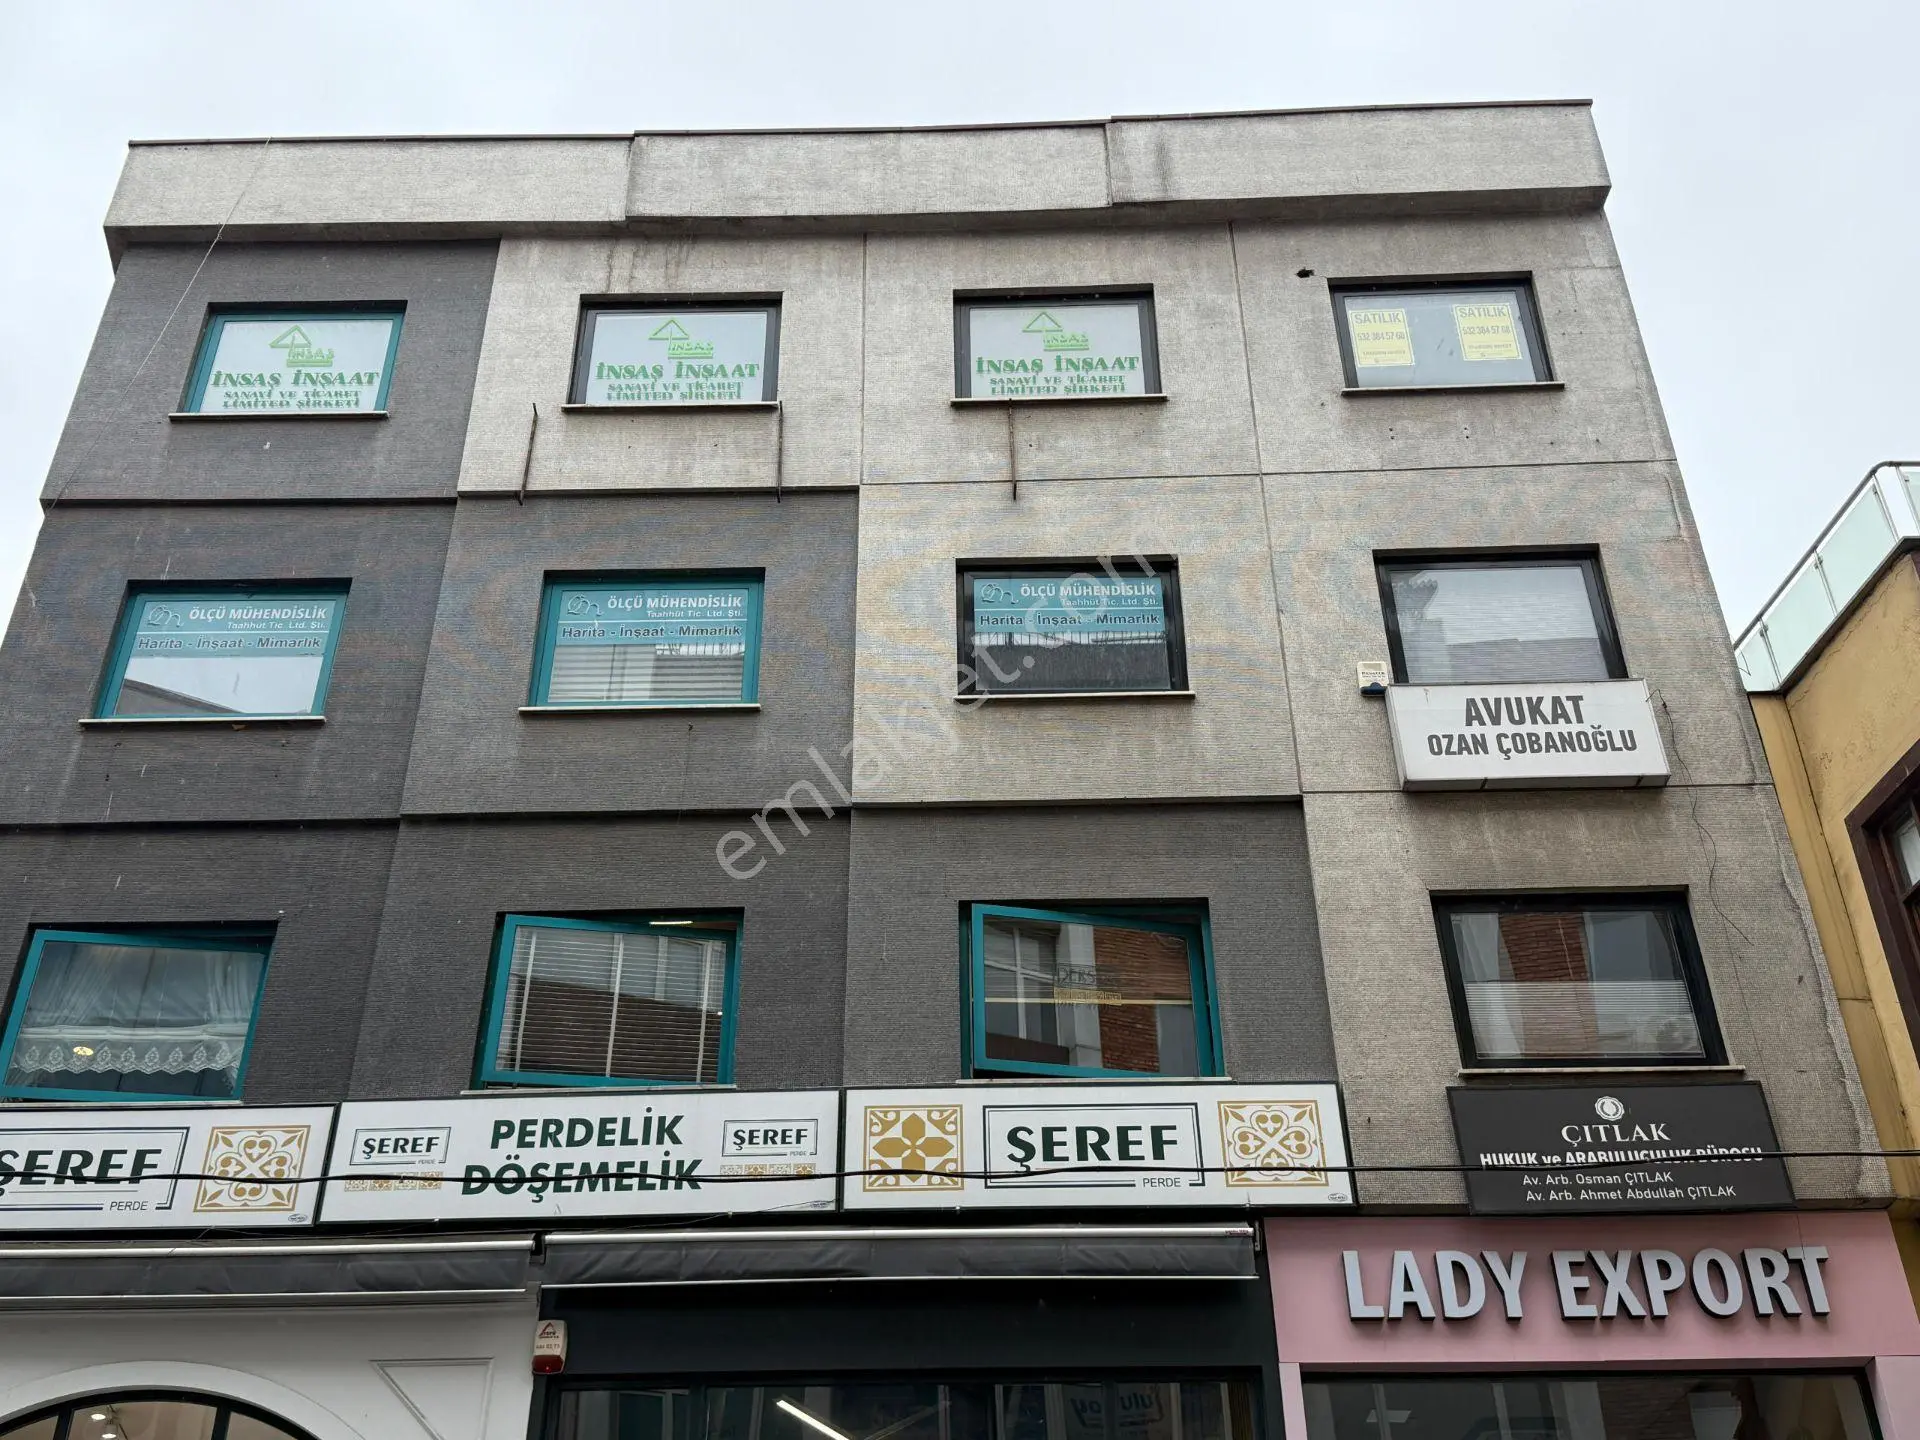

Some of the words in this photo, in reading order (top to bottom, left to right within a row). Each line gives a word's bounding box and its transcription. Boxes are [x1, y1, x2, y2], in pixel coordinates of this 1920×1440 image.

[1354, 312, 1402, 324] SATILIK
[1459, 306, 1507, 318] SATILIK
[673, 361, 759, 381] İNŞAAT
[1053, 354, 1139, 374] İNŞAAT
[291, 369, 379, 389] İNŞAAT
[607, 381, 655, 392] SANAYİ
[662, 382, 680, 392] VE
[685, 381, 743, 391] TİCARET
[989, 375, 1036, 386] SANAYİ
[1043, 376, 1062, 385] VE
[1068, 374, 1126, 384] TİCARET
[223, 389, 273, 399] SANAYİ
[279, 390, 297, 399] VE
[302, 388, 361, 399] TİCARET
[1020, 583, 1056, 599] ÖLÇÜ
[1059, 582, 1156, 597] MÜHENDİSLİK
[607, 595, 643, 611] ÖLÇÜ
[646, 594, 742, 609] MÜHENDİSLİK
[189, 606, 226, 622] ÖLÇÜ
[229, 605, 328, 620] MÜHENDİSLİK
[980, 614, 1024, 626] Harita
[1036, 611, 1082, 627] İnşaat
[1095, 613, 1160, 626] Mimarlık
[562, 627, 606, 639] Harita
[620, 624, 664, 640] İnşaat
[678, 624, 741, 637] Mimarlık
[138, 637, 183, 649] Harita
[196, 634, 244, 650] İnşaat
[257, 636, 321, 649] Mimarlık
[1465, 695, 1584, 727] AVUKAT
[1427, 733, 1489, 756] OZAN
[1495, 724, 1638, 760] ÇOBANOĞLU
[490, 1106, 684, 1149] PERDELİK
[1561, 1123, 1671, 1147] ÇITLAK
[733, 1128, 808, 1151] ŞEREF
[362, 1137, 440, 1160] ŞEREF
[1006, 1125, 1178, 1172] ŞEREF
[1480, 1152, 1538, 1168] HUKUK
[1541, 1155, 1562, 1166] ve
[461, 1150, 703, 1203] DÖŞEMELİK
[1142, 1178, 1181, 1188] PERDE
[1523, 1174, 1542, 1185] Av.
[1545, 1173, 1573, 1185] Arb.
[1576, 1173, 1621, 1185] Osman
[1624, 1171, 1674, 1186] ÇITLAK
[1526, 1190, 1546, 1201] Av.
[1549, 1189, 1576, 1201] Arb.
[1580, 1188, 1622, 1200] Ahmet
[1626, 1187, 1684, 1199] Abdullah
[1687, 1185, 1737, 1200] ÇITLAK
[109, 1200, 149, 1212] PERDE
[1341, 1249, 1528, 1321] LADY
[1549, 1246, 1830, 1320] EXPORT
